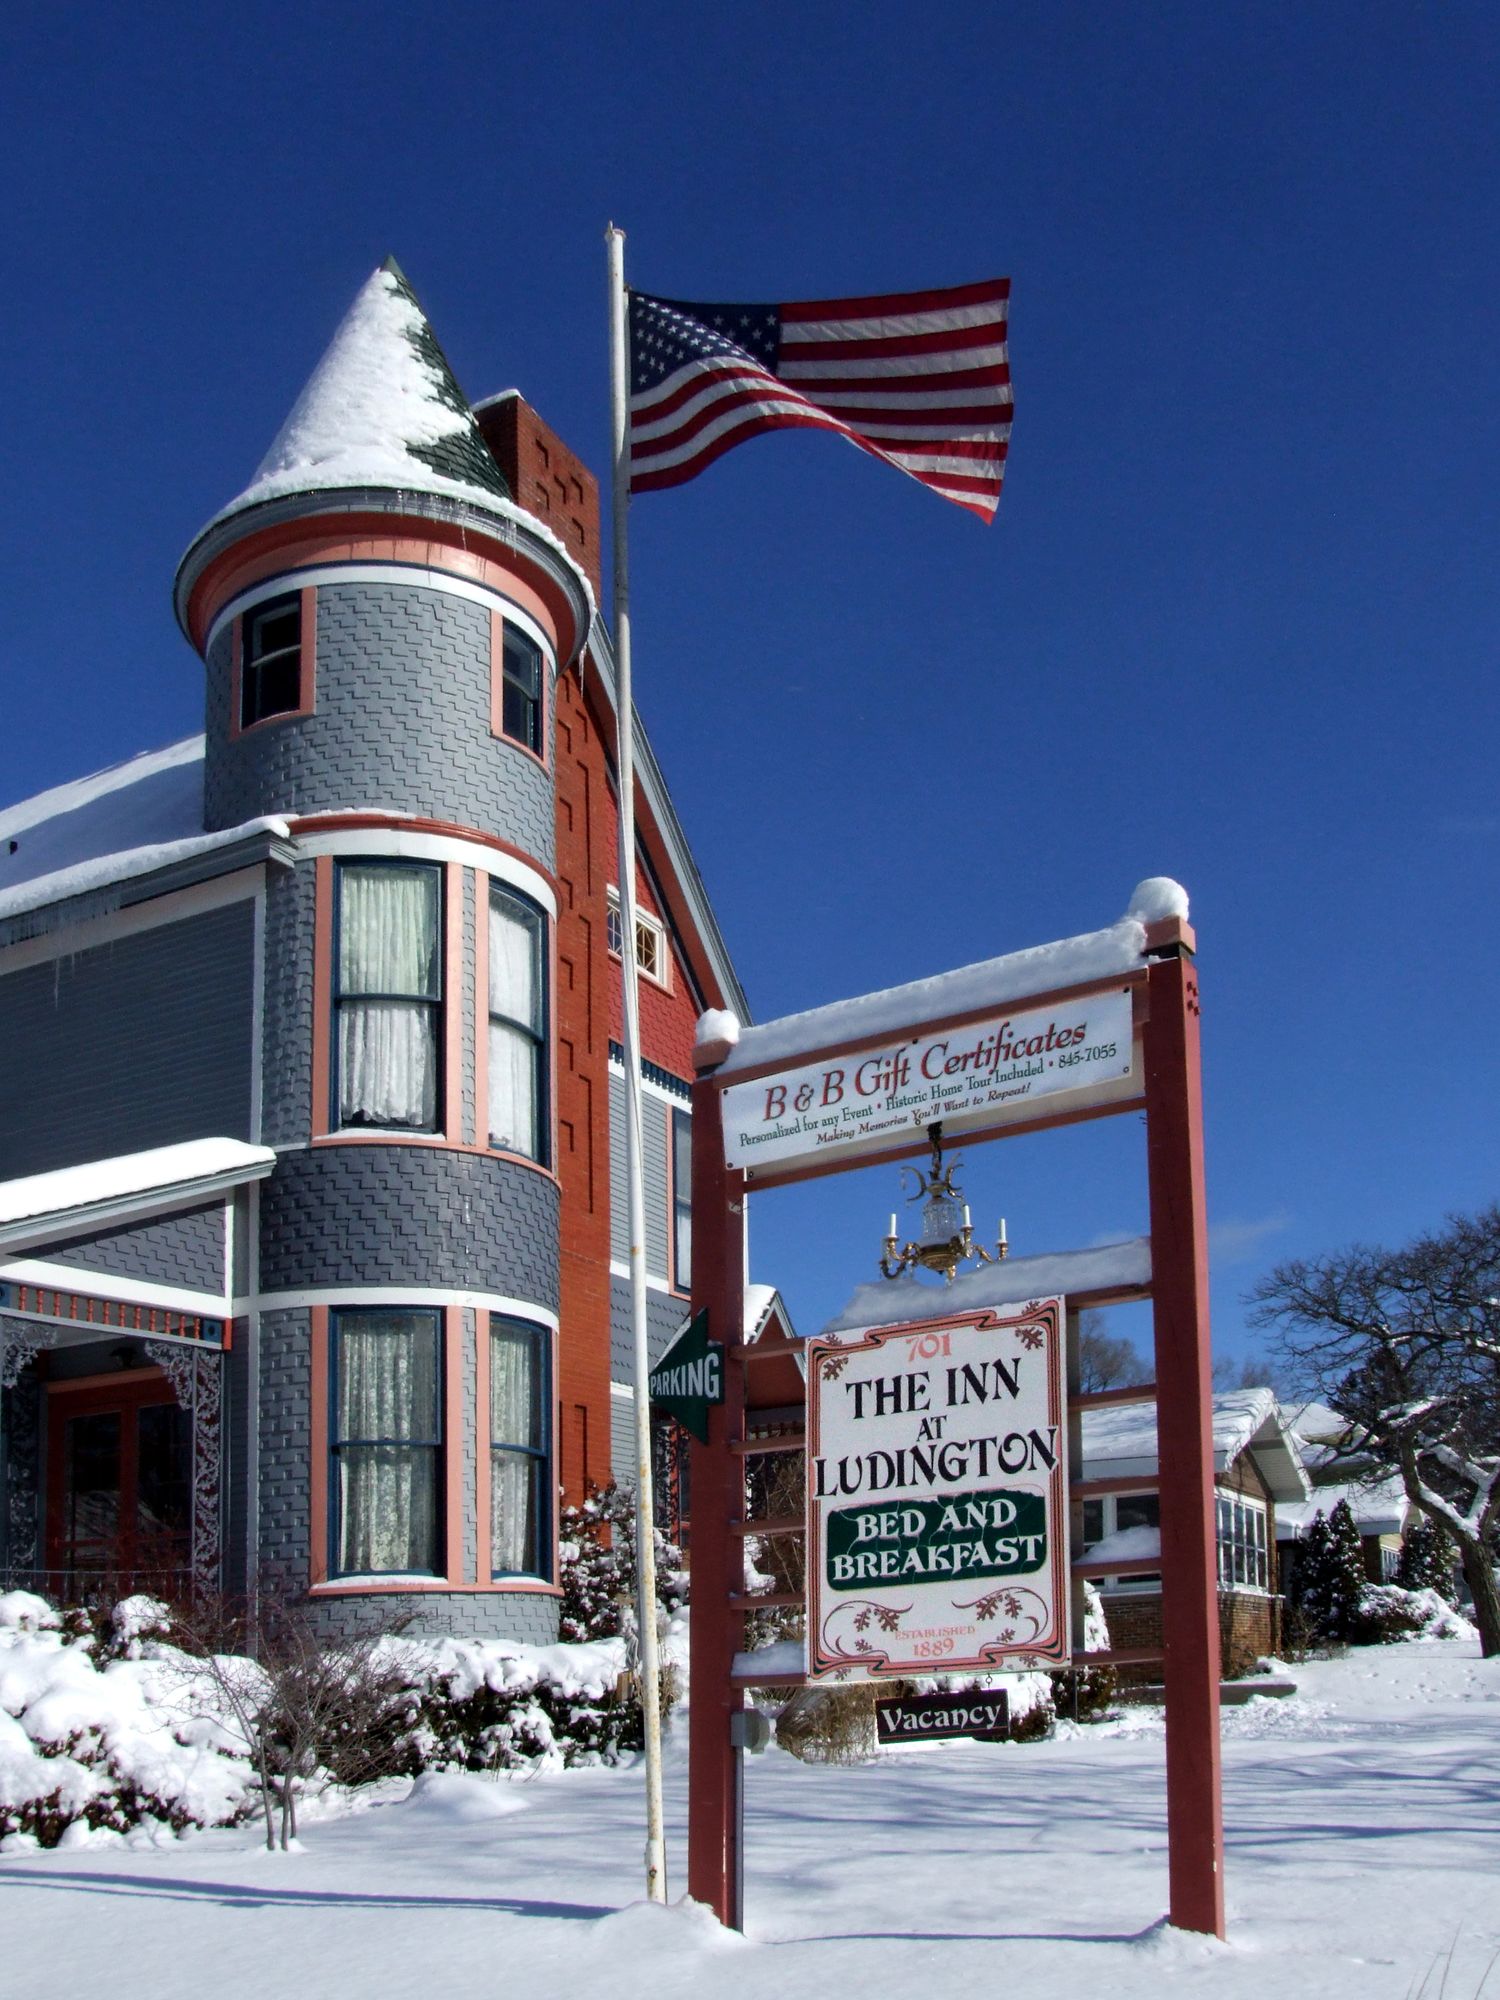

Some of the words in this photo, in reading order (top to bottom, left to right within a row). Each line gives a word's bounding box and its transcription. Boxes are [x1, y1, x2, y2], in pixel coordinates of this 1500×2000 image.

[740, 1120, 801, 1147] Personalized
[803, 1115, 819, 1132] for
[821, 1115, 840, 1131] any
[841, 1105, 873, 1122] Event
[886, 1090, 927, 1111] Historic
[930, 1082, 963, 1100] Home
[965, 1074, 992, 1091] Tour
[995, 1057, 1044, 1084] Included
[1058, 1042, 1117, 1069] 845-7055
[763, 1085, 787, 1121] B
[793, 1083, 815, 1112] &
[819, 1069, 845, 1107] B
[855, 1047, 912, 1098] Gift
[920, 1021, 1087, 1079] Certificates
[816, 1128, 855, 1145] Making
[858, 1115, 908, 1134] Memories
[911, 1100, 941, 1120] You'll
[944, 1099, 969, 1114] Want
[972, 1096, 983, 1106] to
[987, 1082, 1031, 1102] Repeat!
[906, 1333, 952, 1363] 701
[650, 1352, 720, 1399] PARKING
[845, 1372, 930, 1419] THE
[946, 1357, 1022, 1405] INN
[916, 1415, 947, 1442] AT
[814, 1427, 1058, 1497] LUDINGTON
[856, 1507, 926, 1543] BED
[936, 1498, 1017, 1532] AND
[832, 1534, 1044, 1581] BREAKFAST
[895, 1625, 976, 1640] ESTABLISHED
[913, 1638, 955, 1657] 1889
[881, 1702, 1001, 1733] Vacancy
